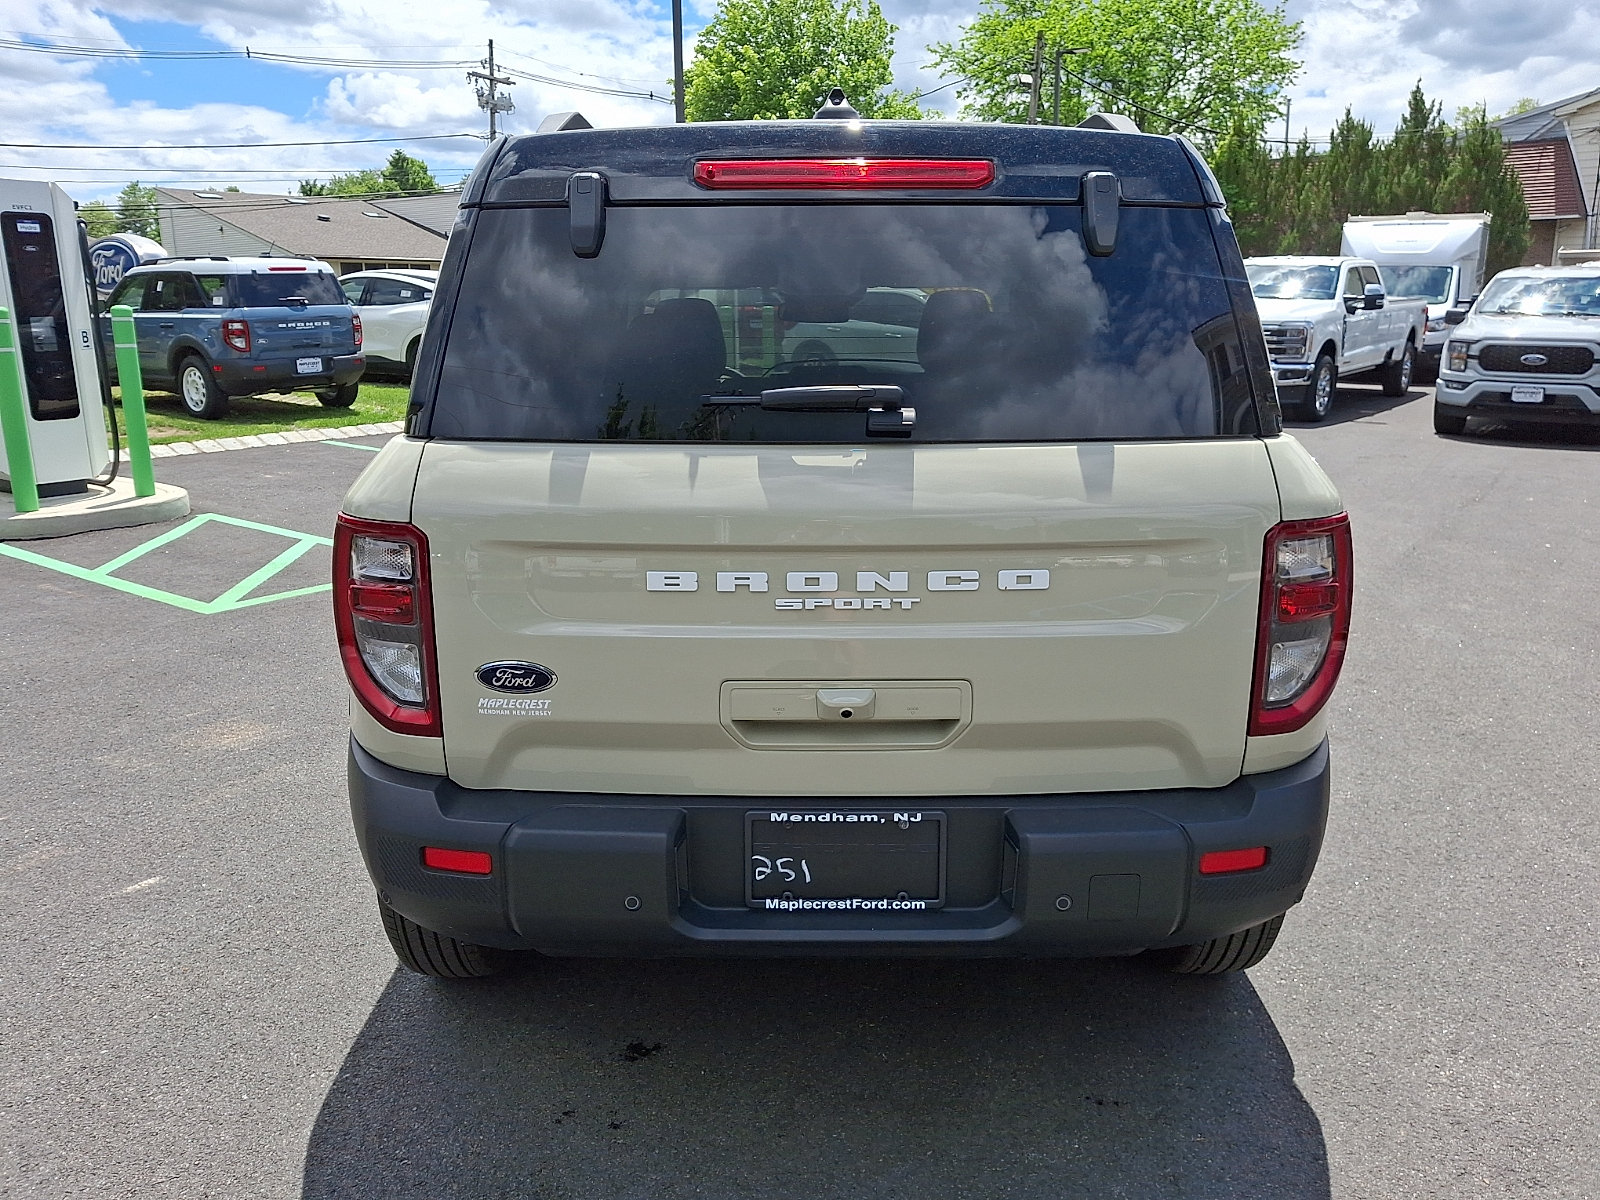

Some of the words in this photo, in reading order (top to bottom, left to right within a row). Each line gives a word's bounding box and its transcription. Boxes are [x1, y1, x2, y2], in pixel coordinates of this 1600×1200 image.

[92, 249, 125, 285] Ford
[81, 331, 89, 343] B
[646, 569, 1051, 592] BRONCO
[775, 598, 921, 610] SPORT
[492, 668, 537, 687] Ford
[478, 698, 552, 709] MAPLECREST
[770, 812, 886, 824] Mendham,
[893, 812, 922, 822] NJ
[751, 855, 811, 884] 251
[765, 899, 926, 912] MaplecrestFord.com
